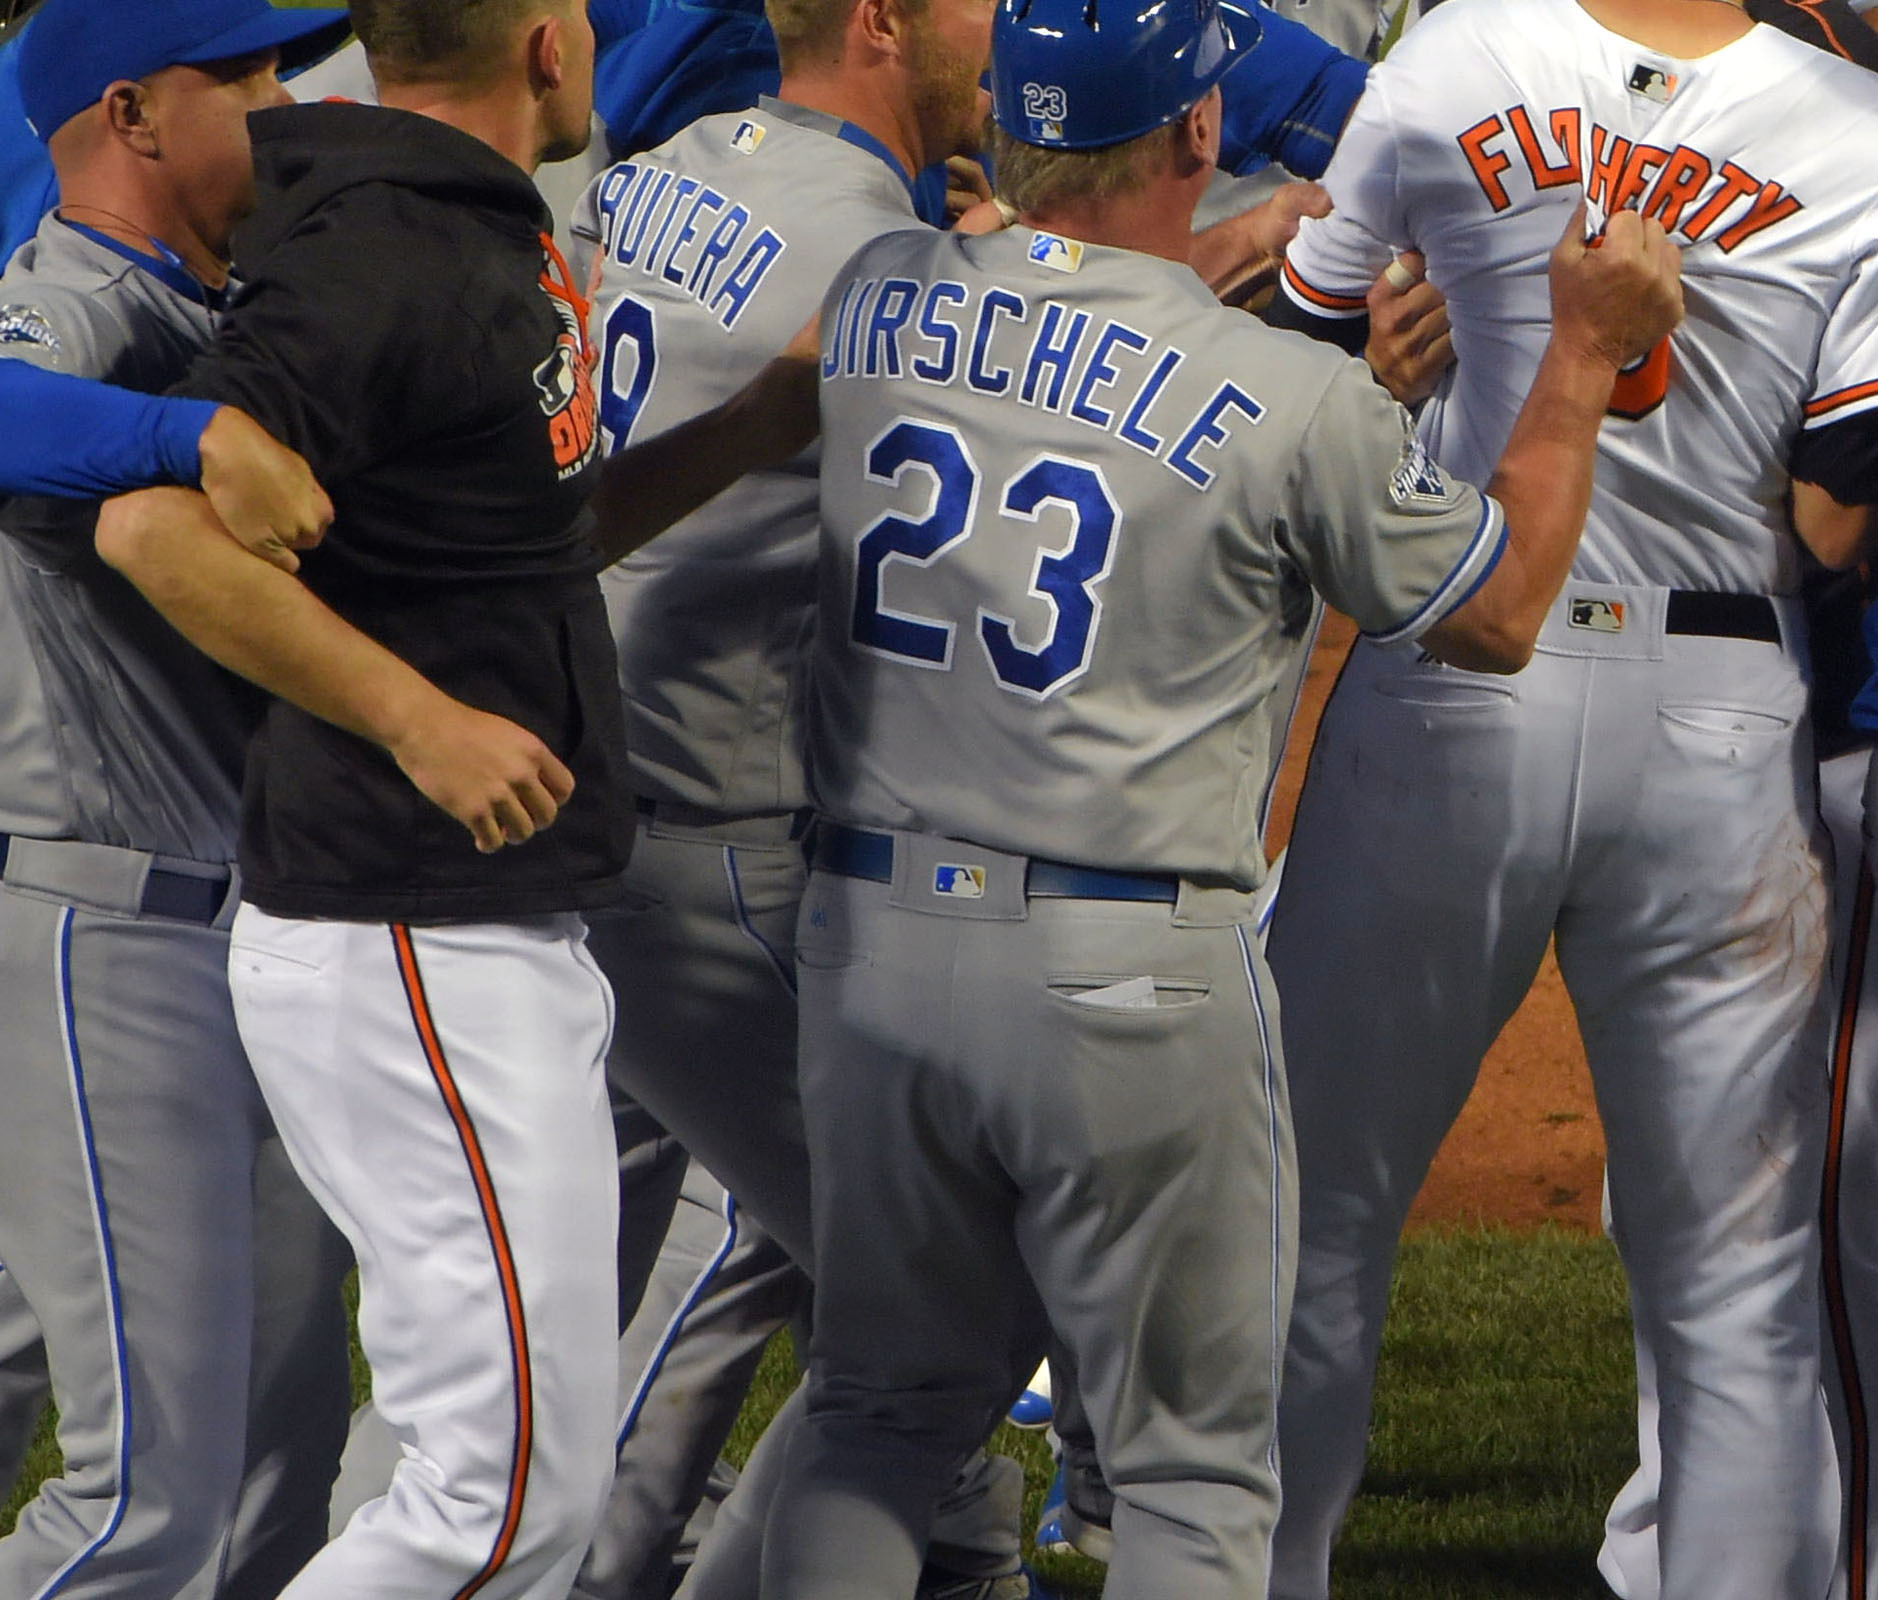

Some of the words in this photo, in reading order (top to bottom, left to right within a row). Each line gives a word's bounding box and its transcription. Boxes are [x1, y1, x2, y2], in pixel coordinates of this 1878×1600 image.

[1022, 82, 1068, 121] 23
[598, 161, 788, 333] BUTERA
[822, 277, 1268, 492] JIRSCHELE
[850, 414, 1124, 702] 23
